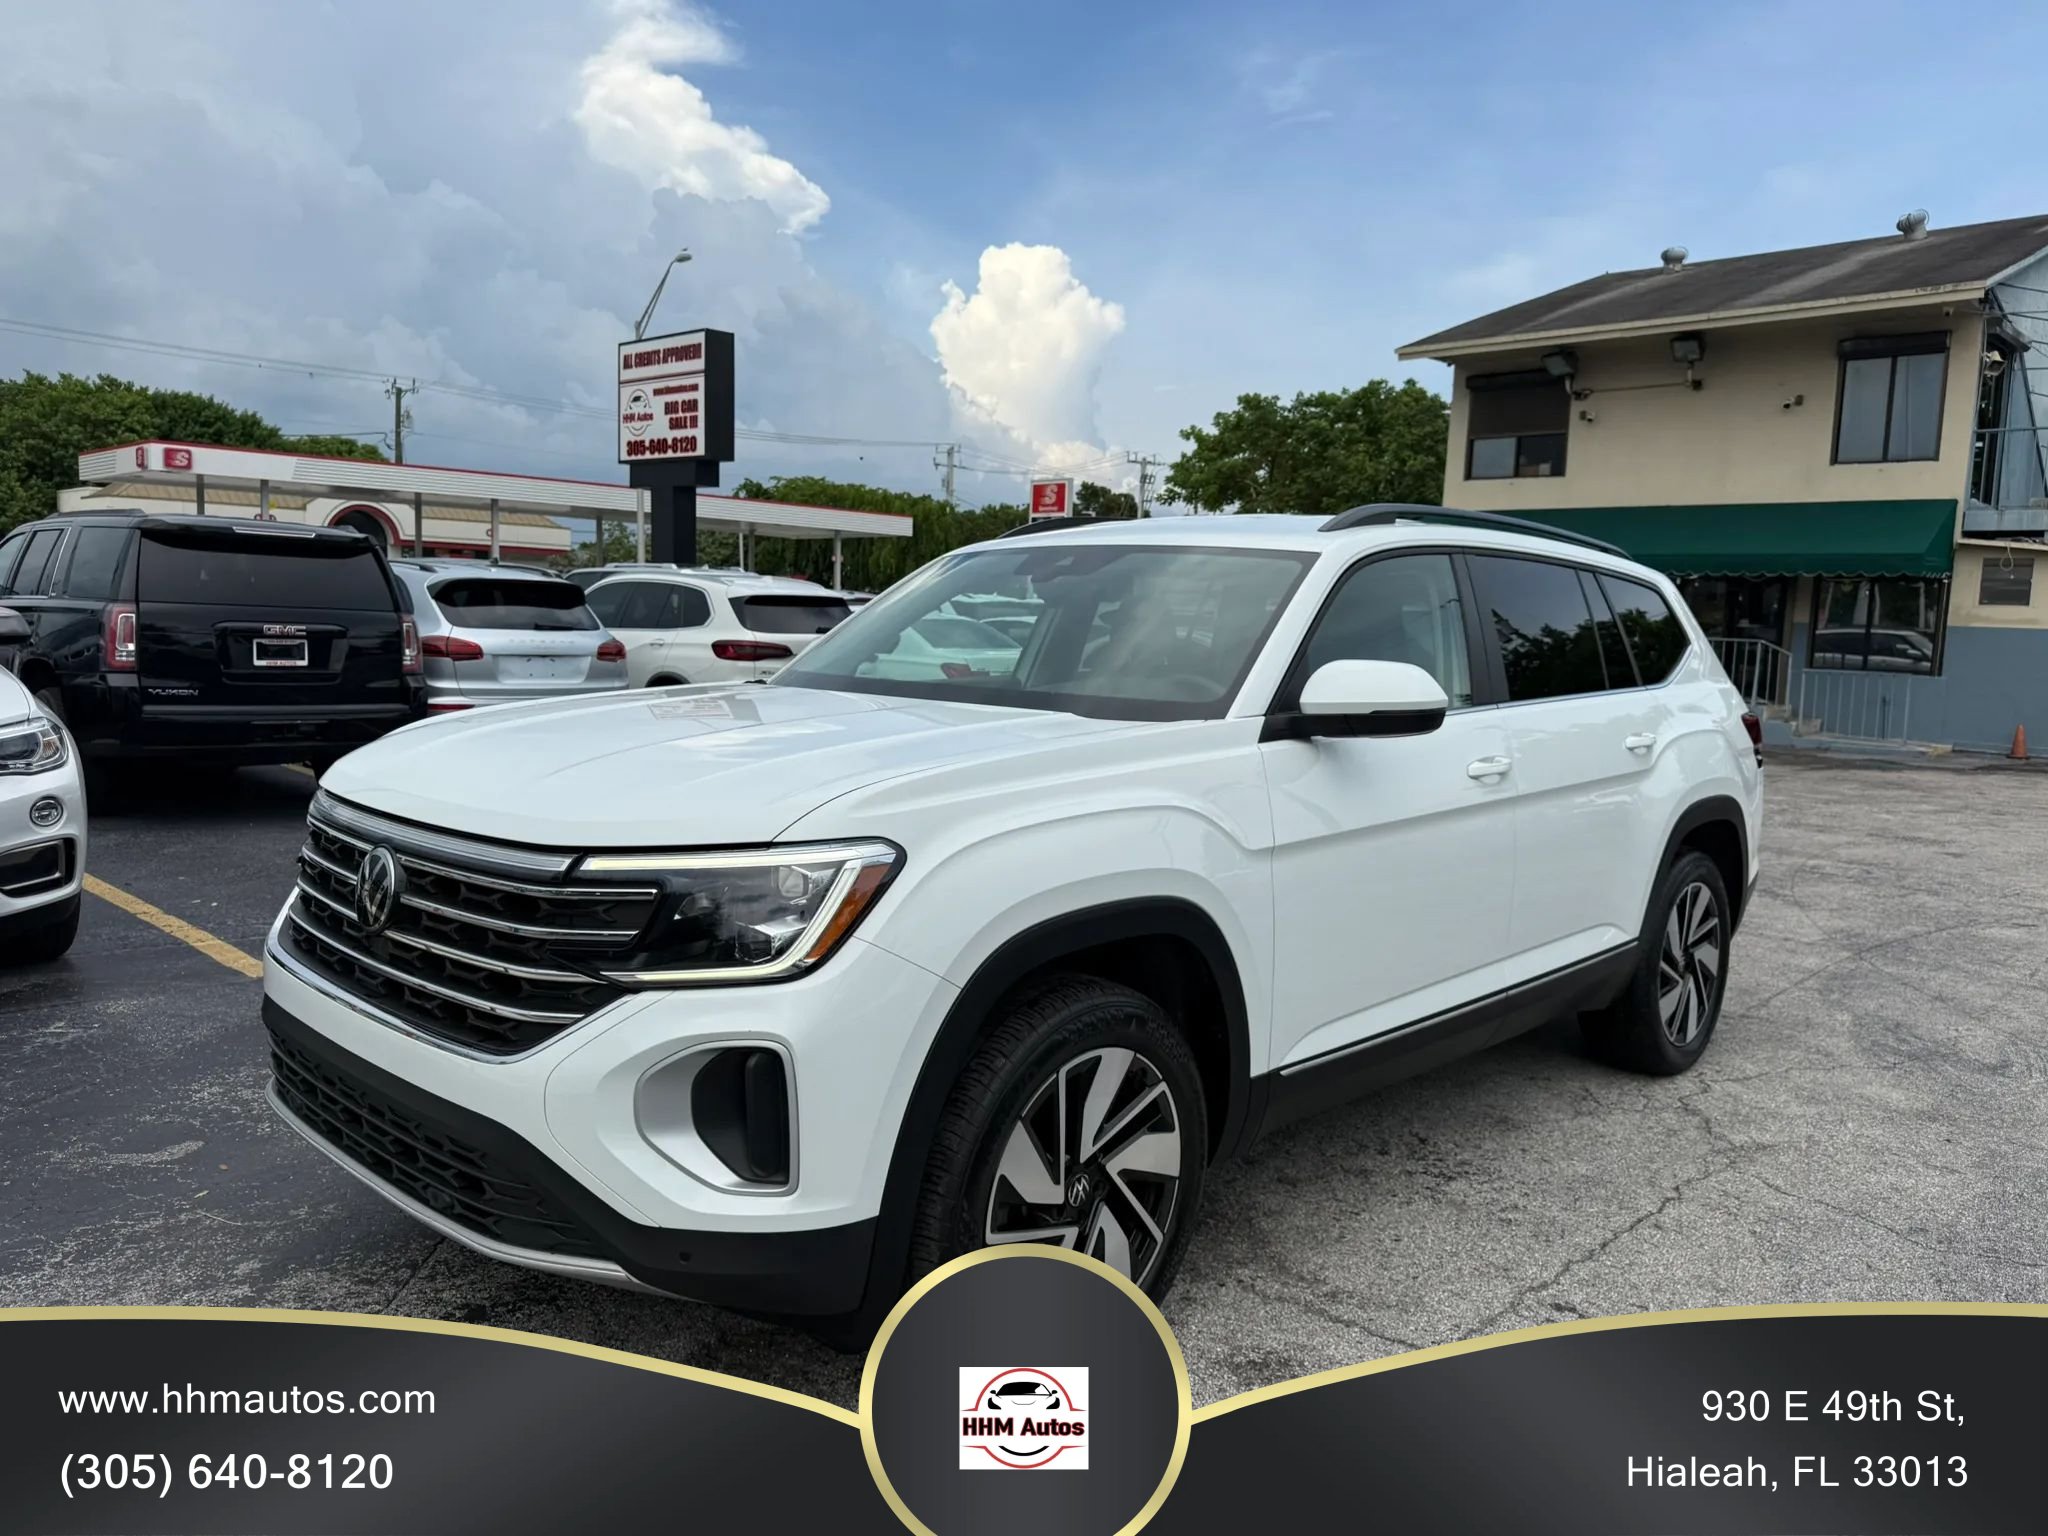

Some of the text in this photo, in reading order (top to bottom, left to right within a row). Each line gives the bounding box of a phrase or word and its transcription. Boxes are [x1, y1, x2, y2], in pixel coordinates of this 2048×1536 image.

[623, 354, 633, 370] ALL
[634, 349, 661, 368] CREDITS
[664, 399, 698, 415] BIG CAR
[669, 416, 688, 430] SALE
[626, 435, 697, 457] 305-640-8120
[263, 624, 307, 636] GMC
[148, 688, 199, 696] YUKON
